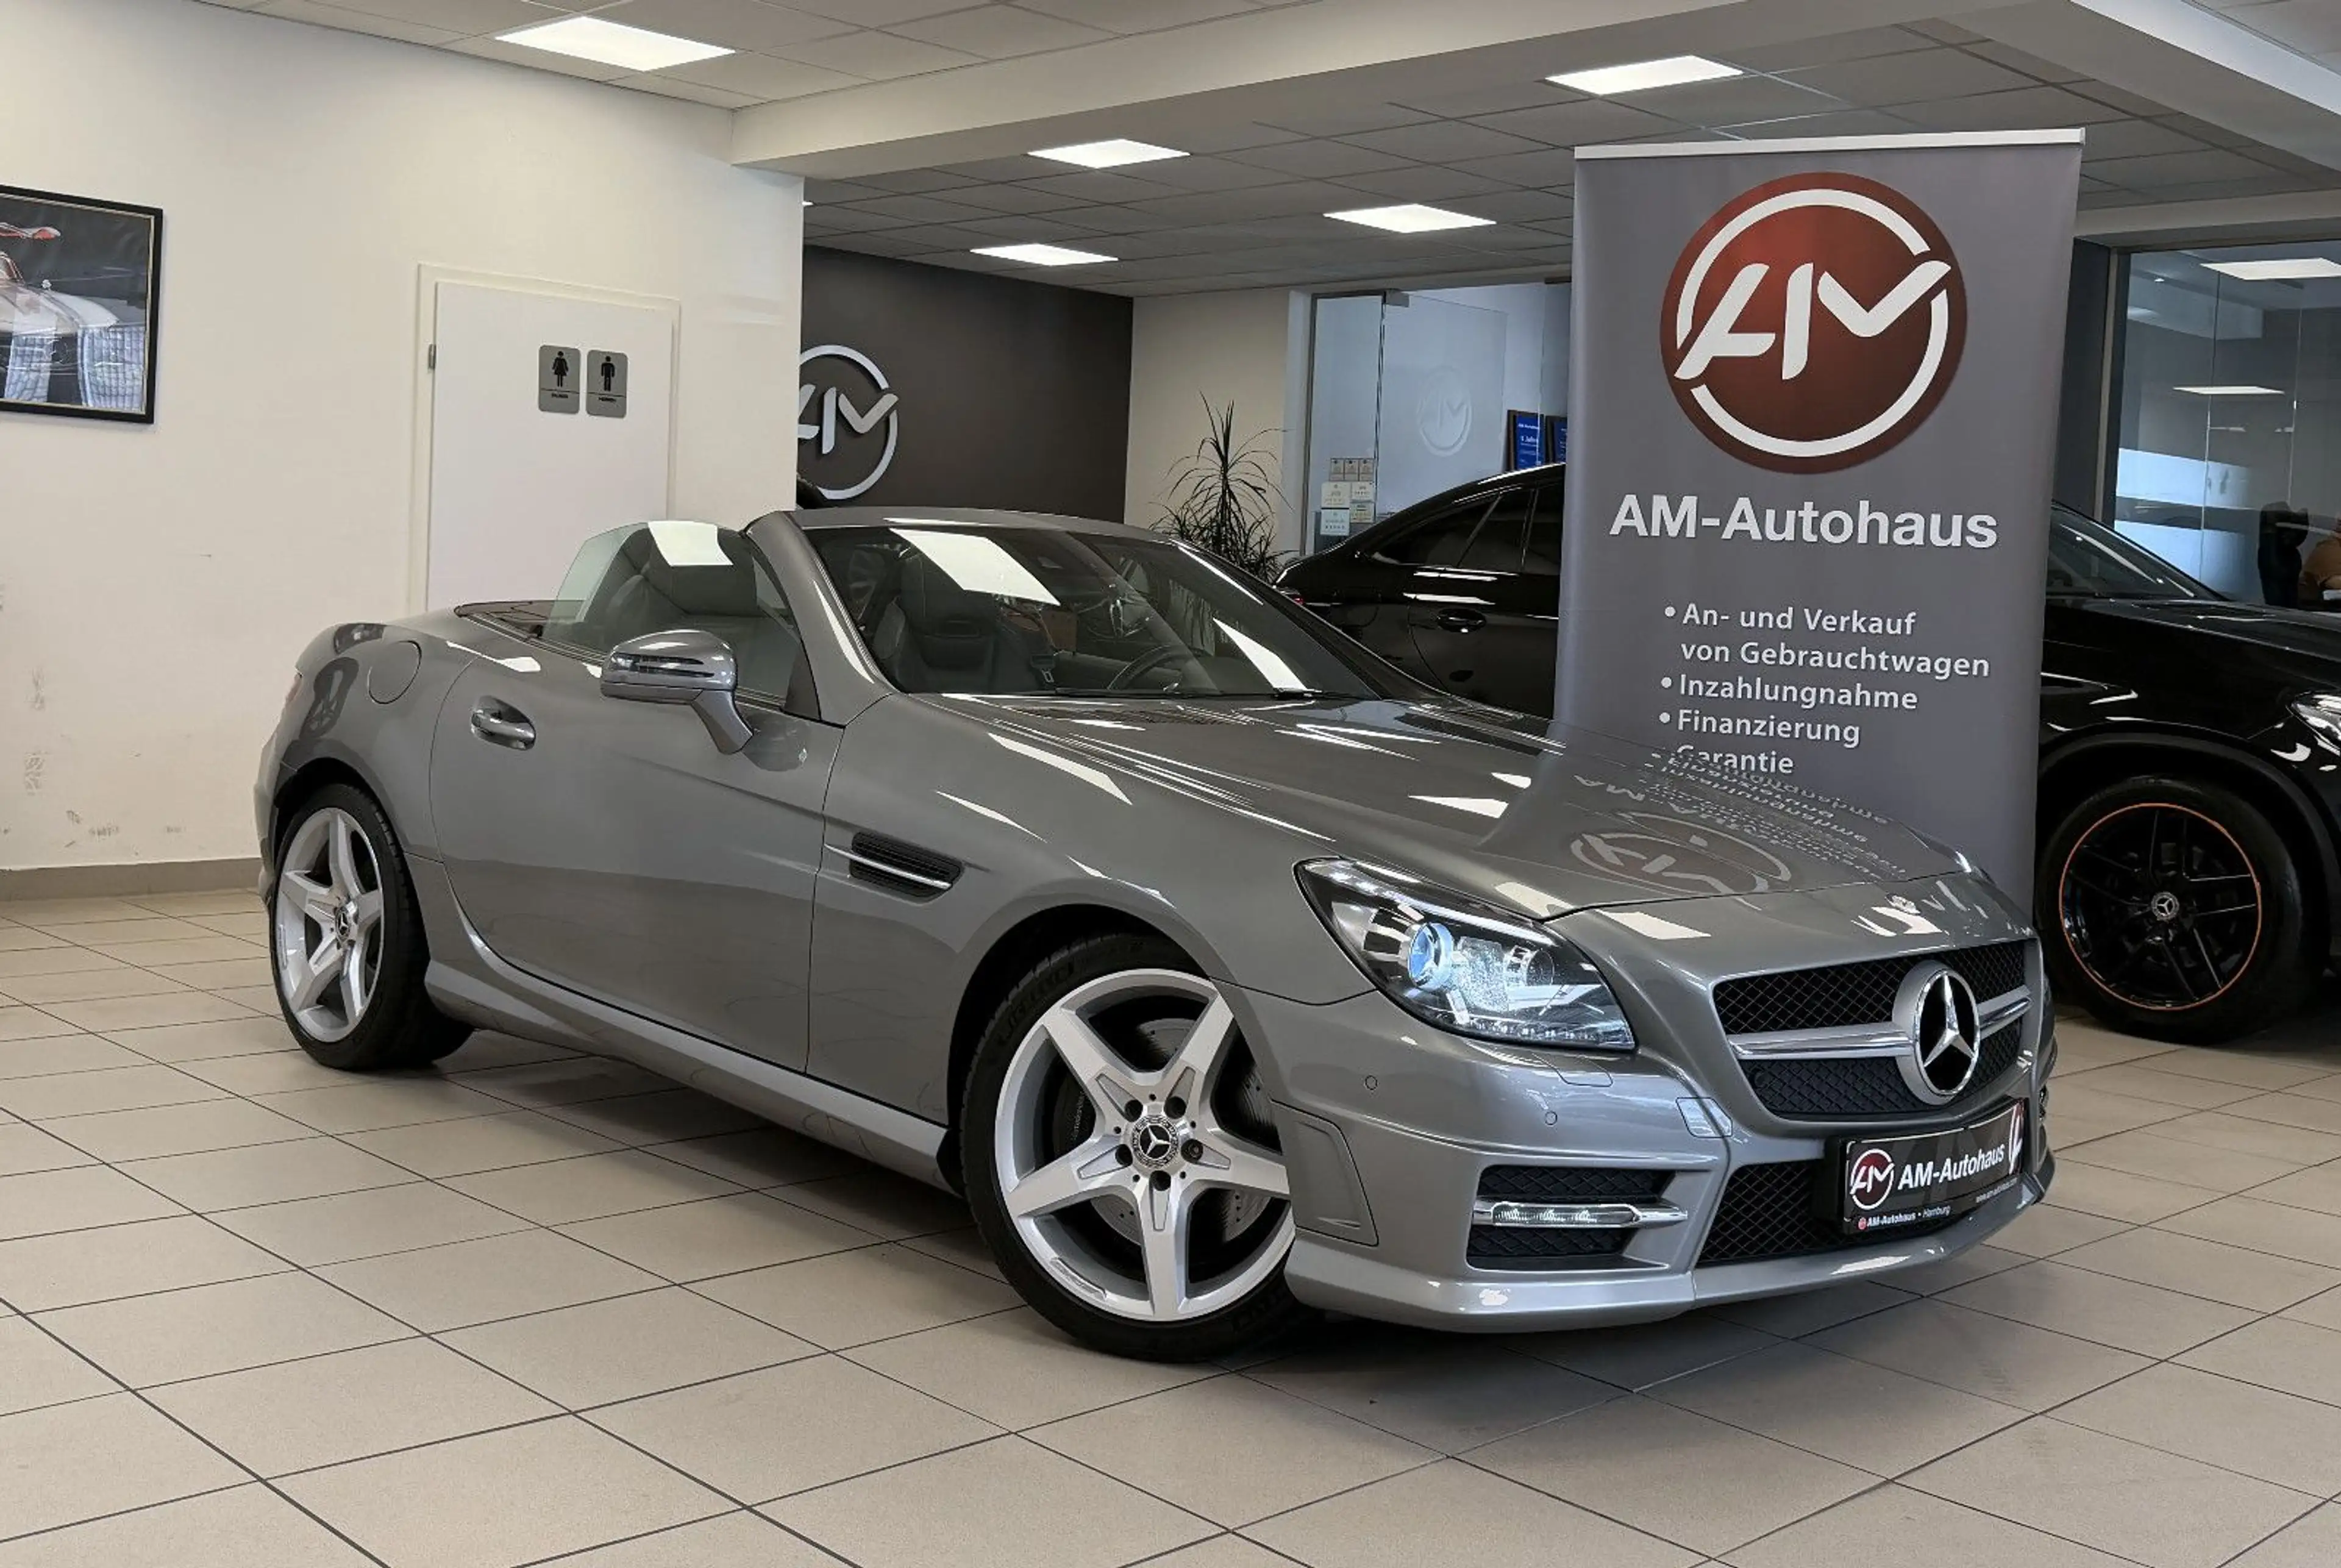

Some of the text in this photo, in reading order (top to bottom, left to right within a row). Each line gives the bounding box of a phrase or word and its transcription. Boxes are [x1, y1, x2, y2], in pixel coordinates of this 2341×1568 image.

[1675, 260, 1951, 379] AM
[1609, 494, 1998, 549] AM-Autohaus
[1683, 604, 1917, 635] An- und Verkauf
[1681, 641, 1991, 680] von Gebrauchtwagen
[1680, 674, 1919, 709] Inzahlungnahme
[1678, 710, 1861, 749] Finanzierung
[1850, 1161, 1895, 1195] AM
[1897, 1143, 2006, 1191] AM-Autohaus
[1867, 1212, 1916, 1227] AM-Autohaus
